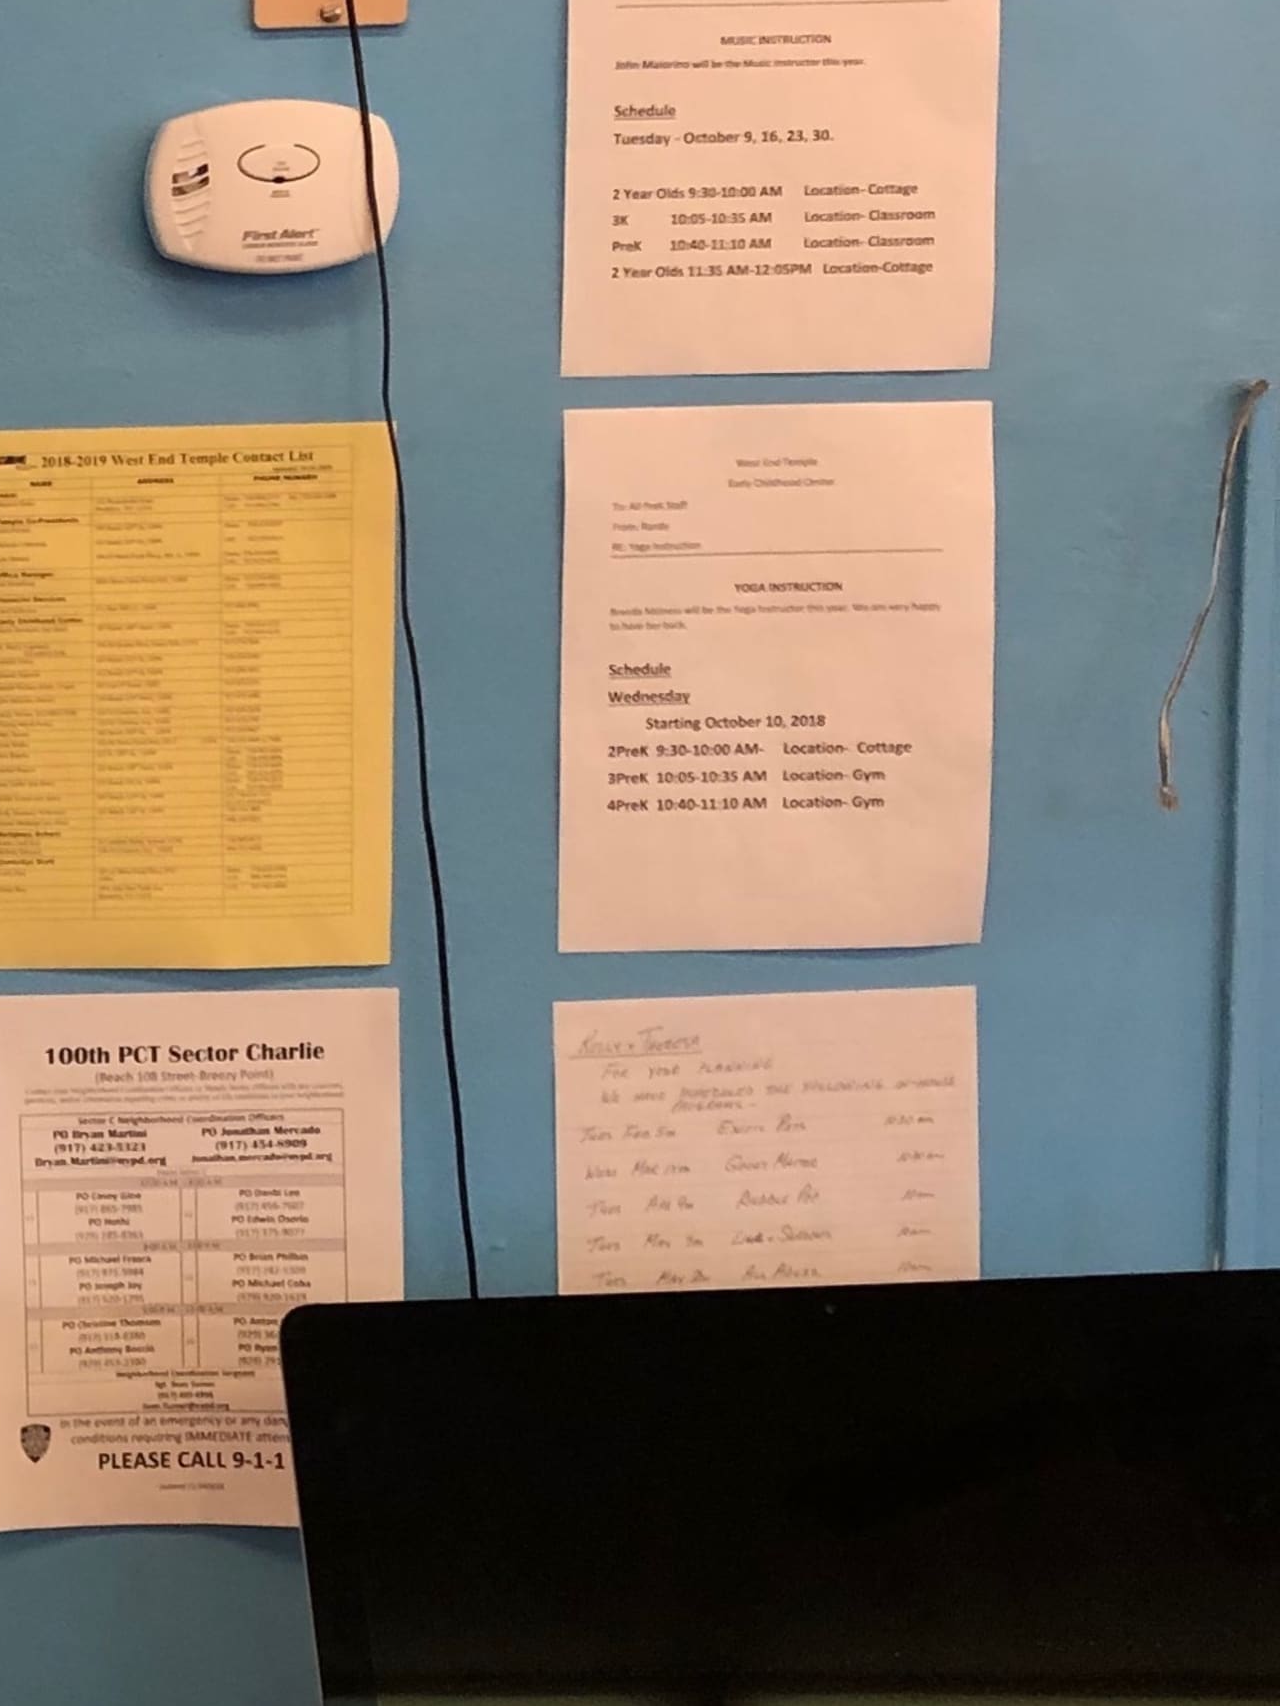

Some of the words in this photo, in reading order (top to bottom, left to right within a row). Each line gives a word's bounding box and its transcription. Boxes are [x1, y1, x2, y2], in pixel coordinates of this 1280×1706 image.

[720, 36, 756, 46] MUSIC
[759, 34, 832, 45] INSTRUCTION
[614, 104, 676, 118] Schedule
[613, 133, 671, 147] Tuesday
[683, 131, 740, 145] October
[743, 131, 757, 144] 9,
[761, 130, 783, 144] 16,
[787, 129, 809, 143] 23,
[813, 129, 834, 142] 30.
[612, 189, 620, 200] 2
[624, 189, 653, 200] Year
[656, 188, 685, 199] Olds
[760, 185, 783, 197] AM
[868, 183, 919, 196] Cottage
[750, 212, 772, 223] AM
[868, 209, 936, 221] Classroom
[242, 230, 277, 242] First
[279, 228, 315, 240] Alert
[749, 238, 772, 249] AM
[868, 235, 935, 247] Classroom
[611, 267, 620, 278] 2
[623, 267, 653, 278] Year
[655, 266, 684, 278] Olds
[41, 455, 108, 468] 2018-2019
[111, 454, 145, 466] West
[148, 454, 175, 465] End
[180, 452, 229, 467] Temple
[232, 451, 285, 463] Contact
[288, 450, 314, 462] List
[734, 582, 766, 593] YOGA
[768, 581, 843, 592] INSTRUCTION
[608, 663, 672, 677] Schedule
[608, 690, 691, 704] Wednesday
[645, 717, 701, 731] Starting
[705, 716, 762, 730] October
[766, 715, 787, 729] 10,
[790, 714, 827, 727] 2018
[607, 745, 649, 758] 2PreK
[655, 744, 731, 757] 9:30-10:00
[857, 741, 913, 756] Cottage
[607, 772, 649, 785] 3PreK
[656, 771, 739, 784] 10:05-10:35
[742, 770, 768, 783] AM
[852, 768, 886, 784] Gym
[607, 799, 649, 812] 4PreK
[656, 798, 739, 811] 10:40-11:10
[742, 797, 768, 809] AM
[851, 795, 885, 811] Gym
[44, 1045, 111, 1065] 100th
[118, 1045, 161, 1063] PCT
[168, 1044, 239, 1063] Sector
[245, 1042, 326, 1061] Charlie
[239, 1068, 274, 1082] Point)
[52, 1130, 69, 1140] PO
[201, 1127, 217, 1138] PO
[73, 1418, 92, 1428] the
[93, 1417, 125, 1428] event
[127, 1415, 141, 1426] of
[159, 1416, 222, 1430] emergency
[70, 1433, 130, 1445] conditions
[184, 1431, 252, 1443] IMMEDIATE
[98, 1451, 171, 1470] PLEASE
[177, 1450, 227, 1469] CALL
[232, 1450, 285, 1470] 9-1-1
